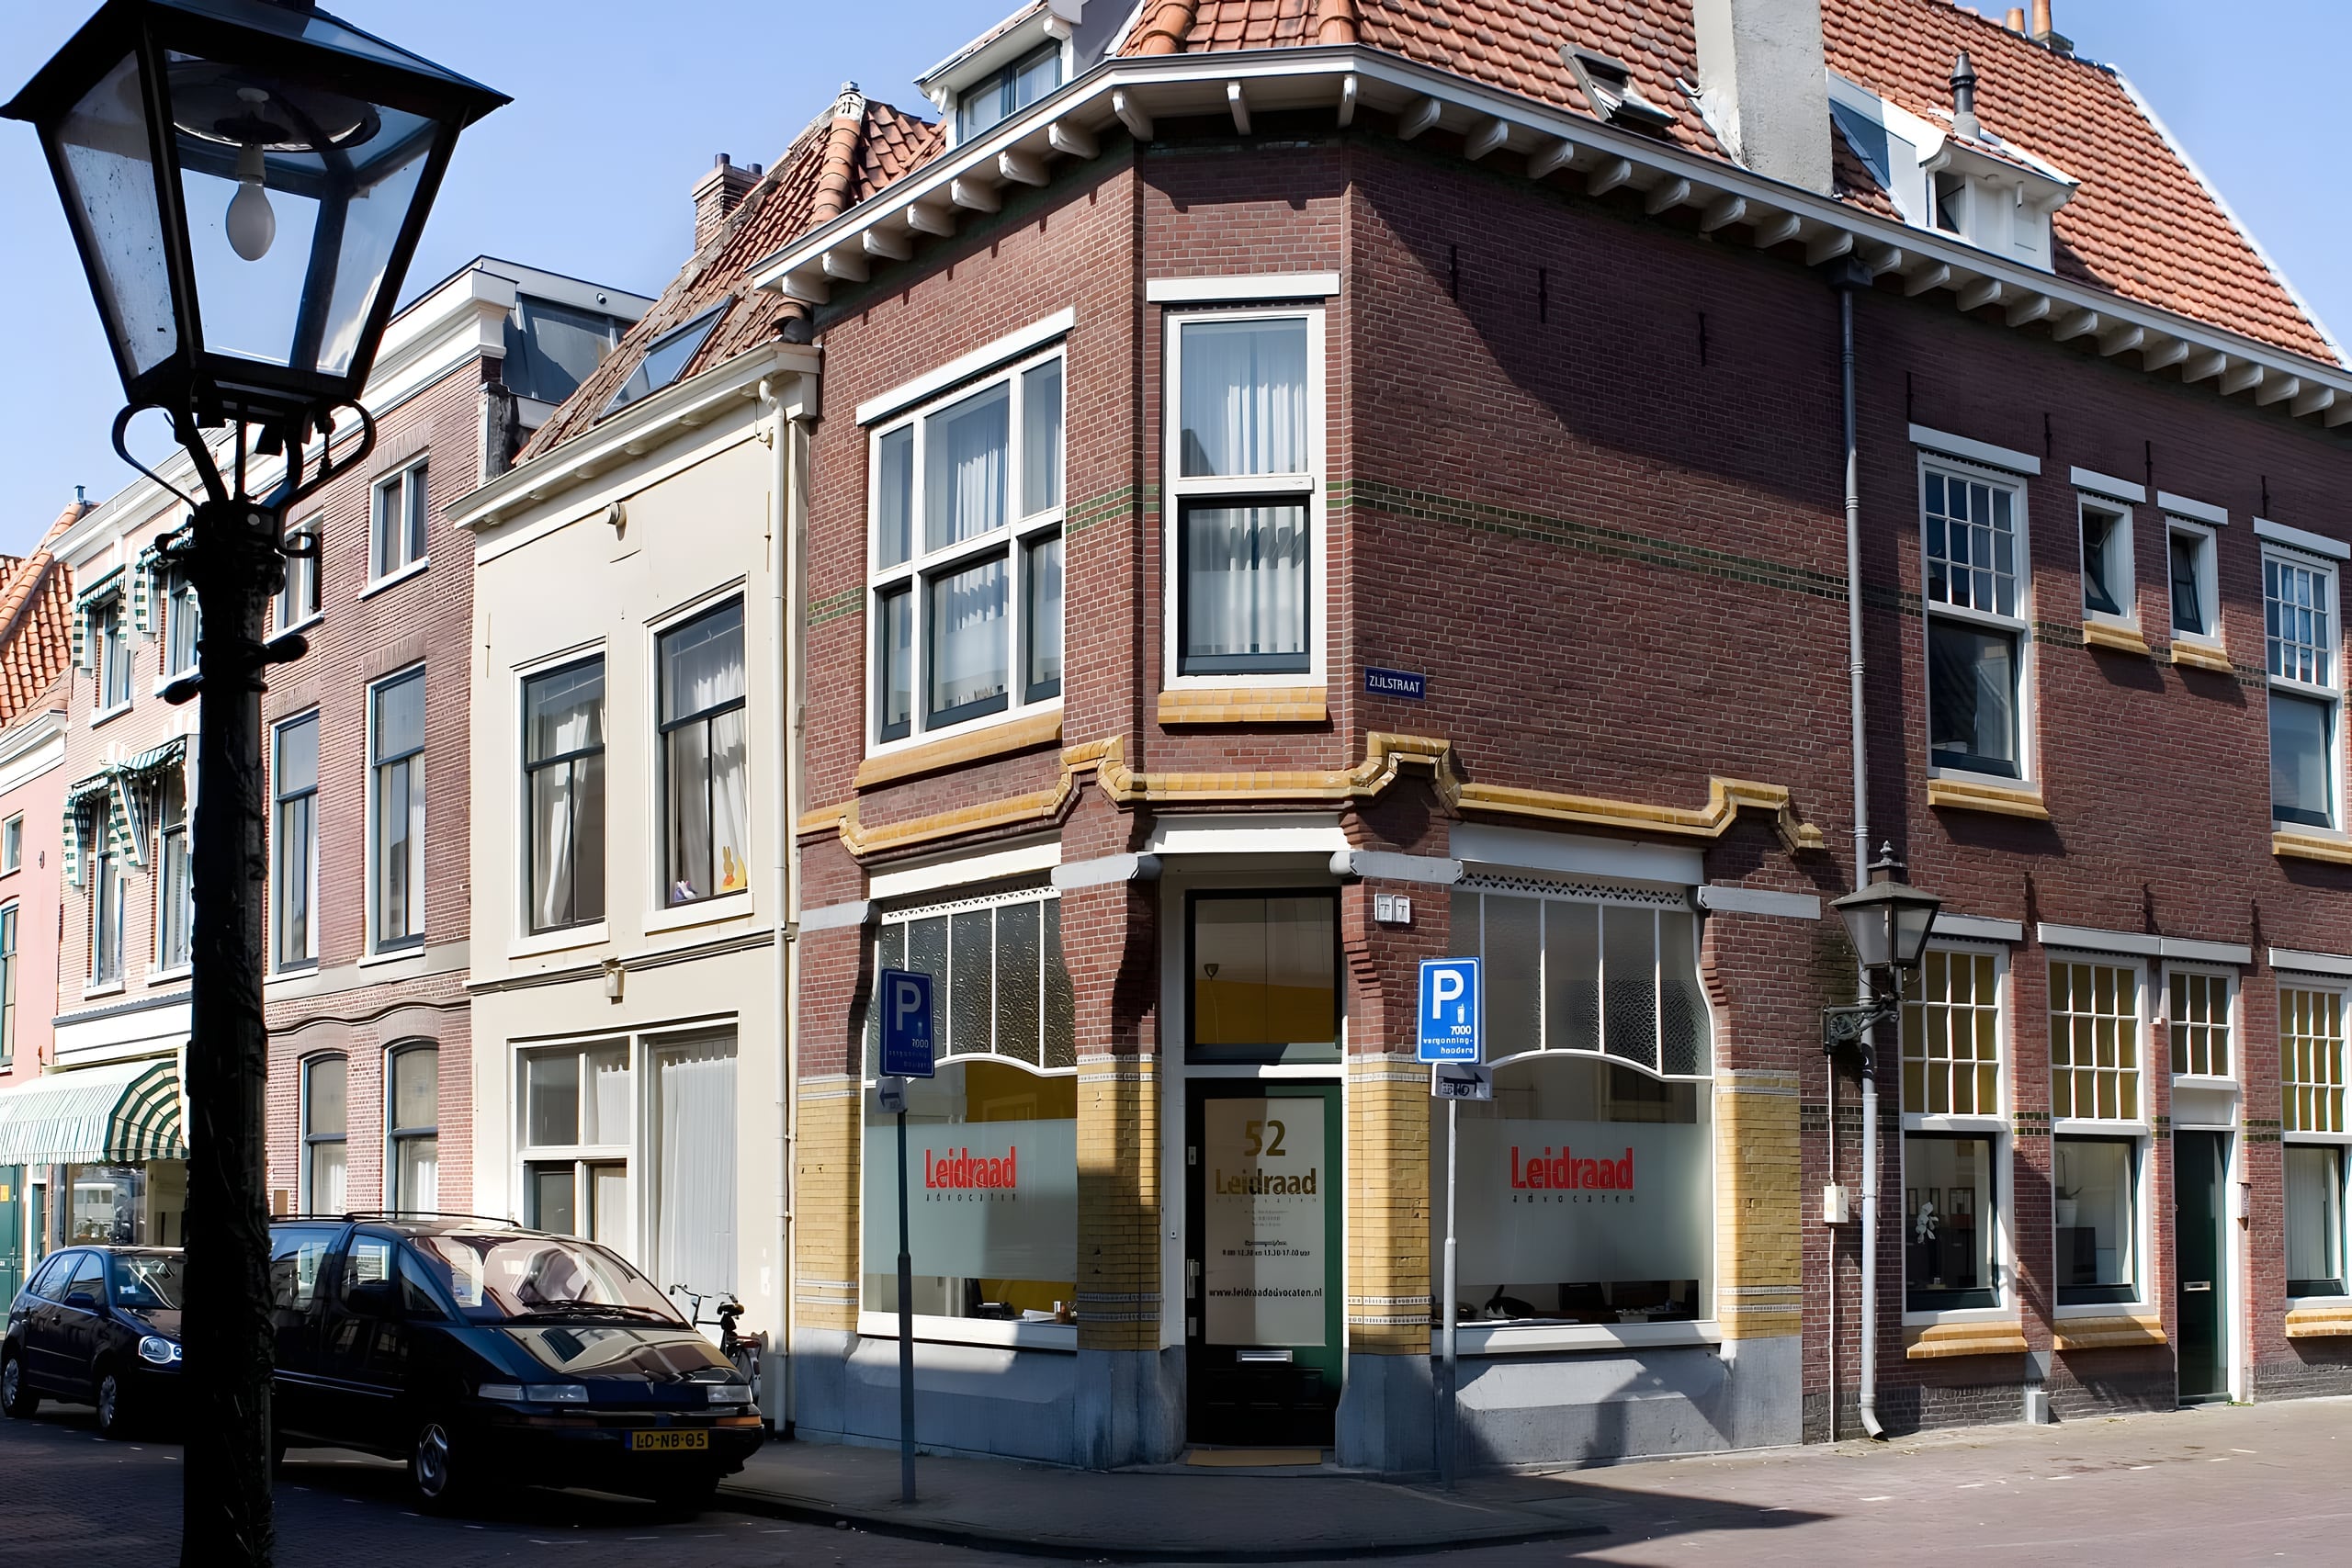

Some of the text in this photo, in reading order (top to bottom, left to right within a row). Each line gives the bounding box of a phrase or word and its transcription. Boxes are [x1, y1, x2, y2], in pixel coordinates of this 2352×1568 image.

[1369, 673, 1420, 694] ZIJLSTRAAT
[896, 980, 922, 1031] P
[1432, 969, 1464, 1020] P
[1450, 1025, 1472, 1035] 7000
[1244, 1120, 1286, 1156] 52
[925, 1145, 1016, 1189] Leidraad
[1216, 1168, 1317, 1195] Leidraad
[1511, 1145, 1634, 1190] Leidraad
